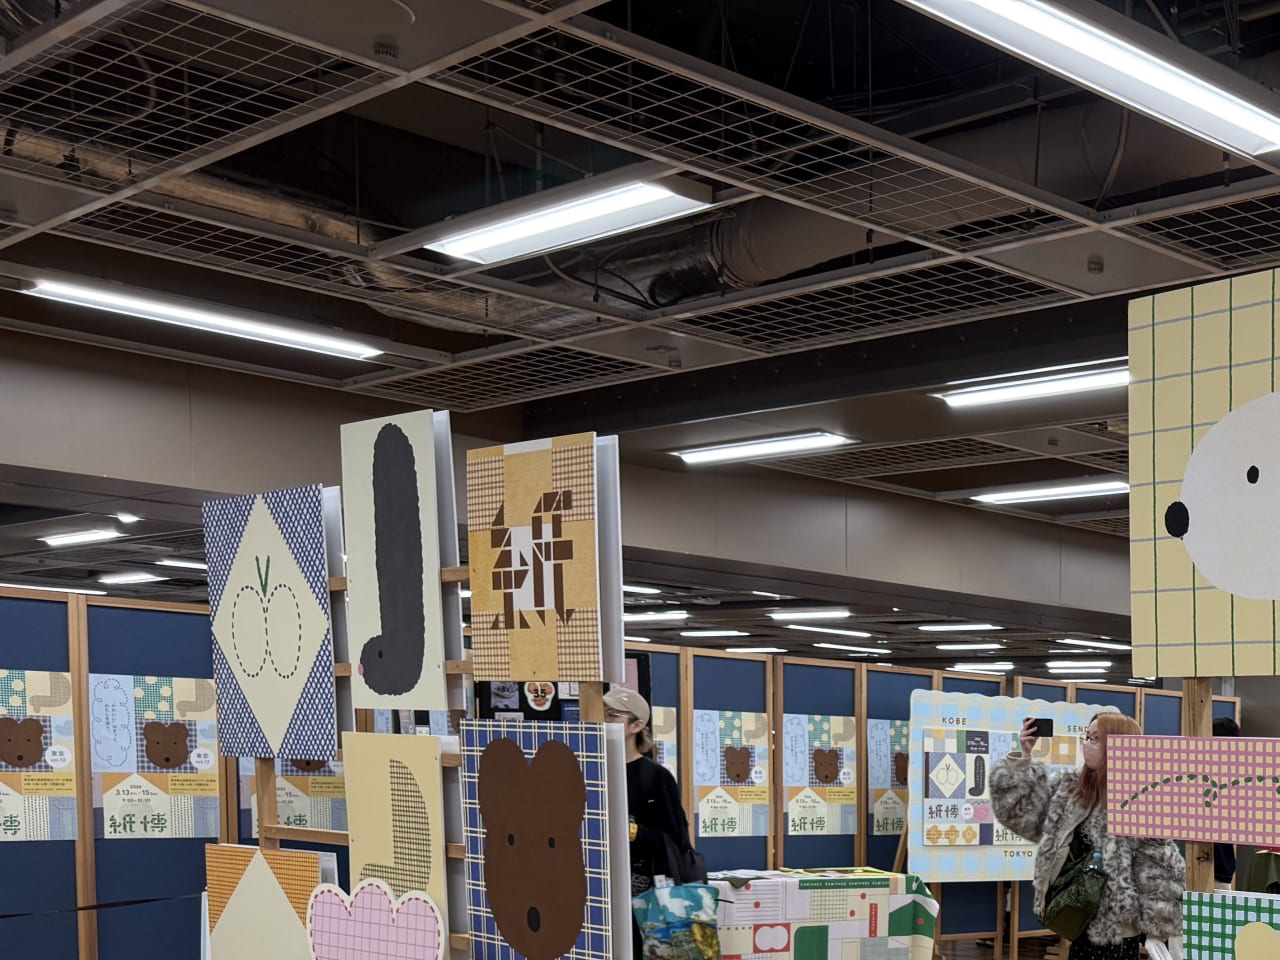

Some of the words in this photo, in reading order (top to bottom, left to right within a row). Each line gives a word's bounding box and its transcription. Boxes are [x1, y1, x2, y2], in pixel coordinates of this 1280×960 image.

[533, 688, 547, 698] 35
[942, 717, 968, 725] KOBE
[108, 812, 168, 834] 紙博
[702, 816, 737, 834] 紙博
[791, 816, 826, 832] 紙博
